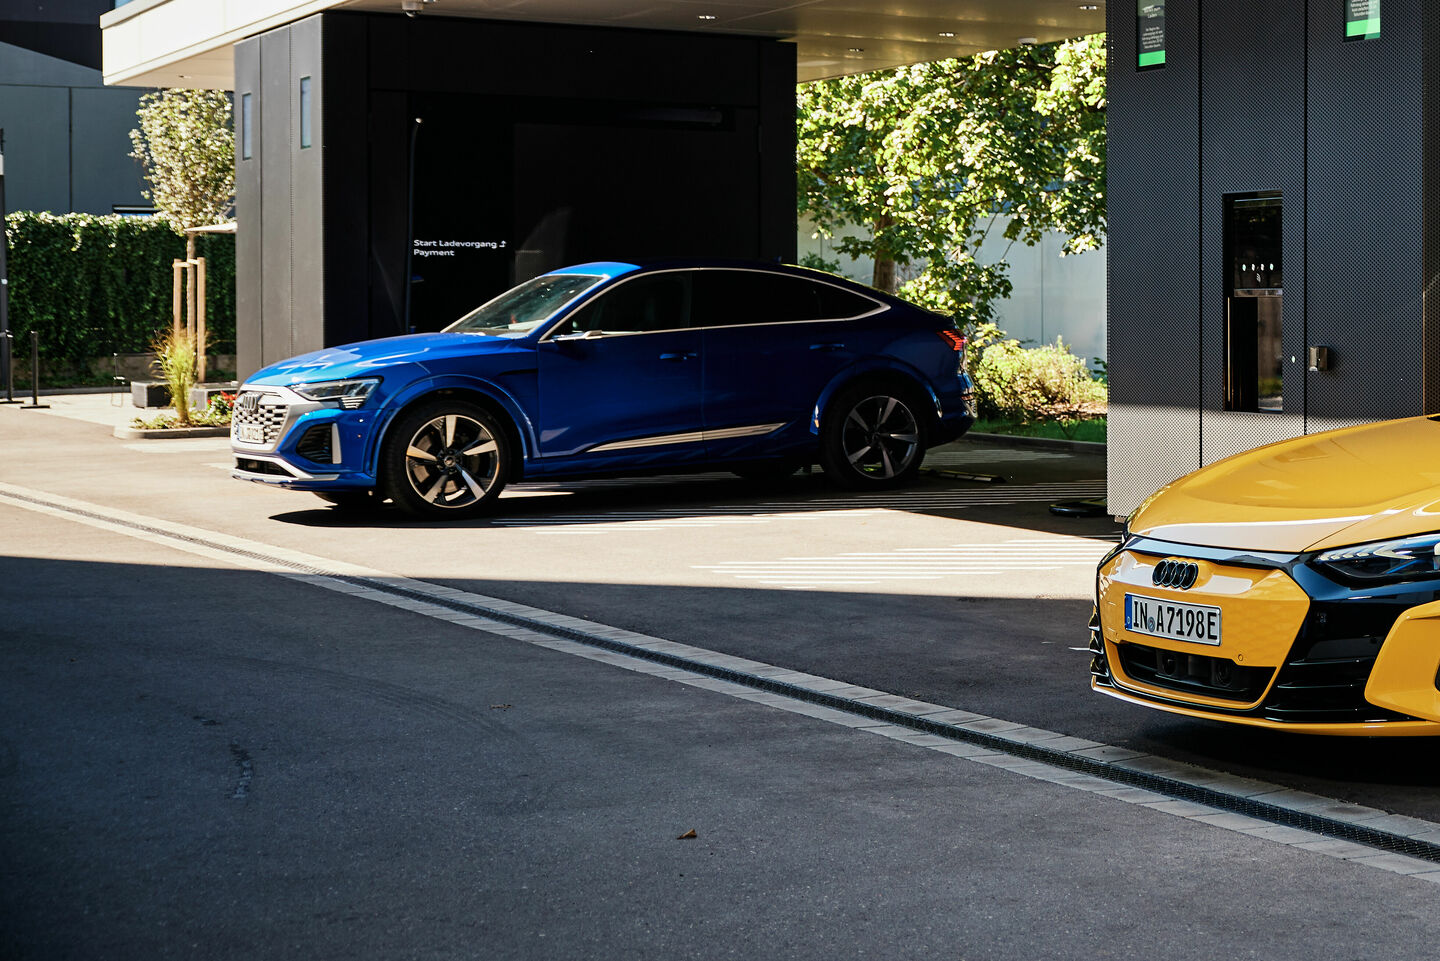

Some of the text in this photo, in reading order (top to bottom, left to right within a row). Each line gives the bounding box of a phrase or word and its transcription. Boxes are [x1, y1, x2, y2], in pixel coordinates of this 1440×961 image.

[439, 240, 497, 249] Ladevorgang
[413, 249, 455, 257] Payment
[1133, 601, 1148, 629] IN
